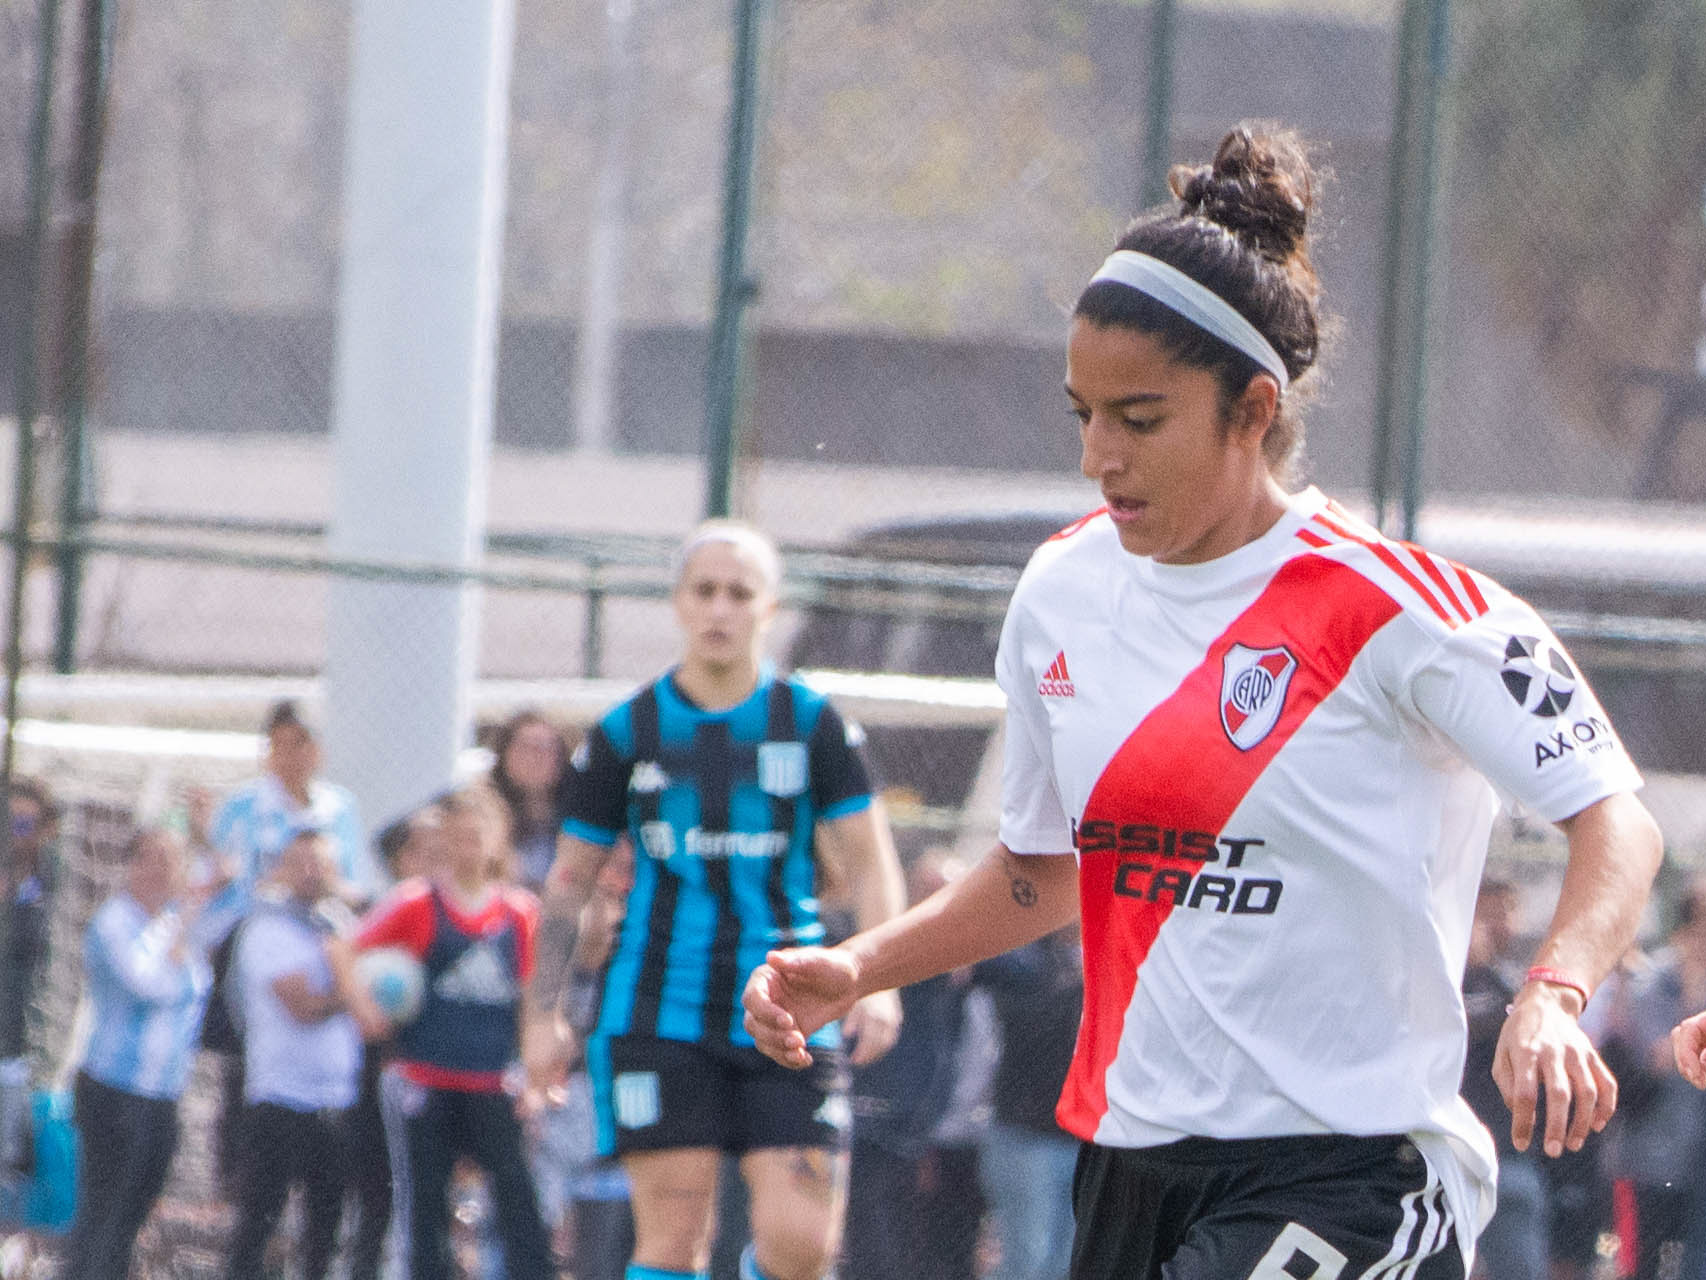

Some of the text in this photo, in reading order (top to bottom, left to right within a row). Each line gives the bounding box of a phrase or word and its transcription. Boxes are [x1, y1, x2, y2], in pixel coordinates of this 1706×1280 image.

[1038, 682, 1076, 698] adidas
[1534, 716, 1609, 768] AXON
[1113, 861, 1283, 915] CARD
